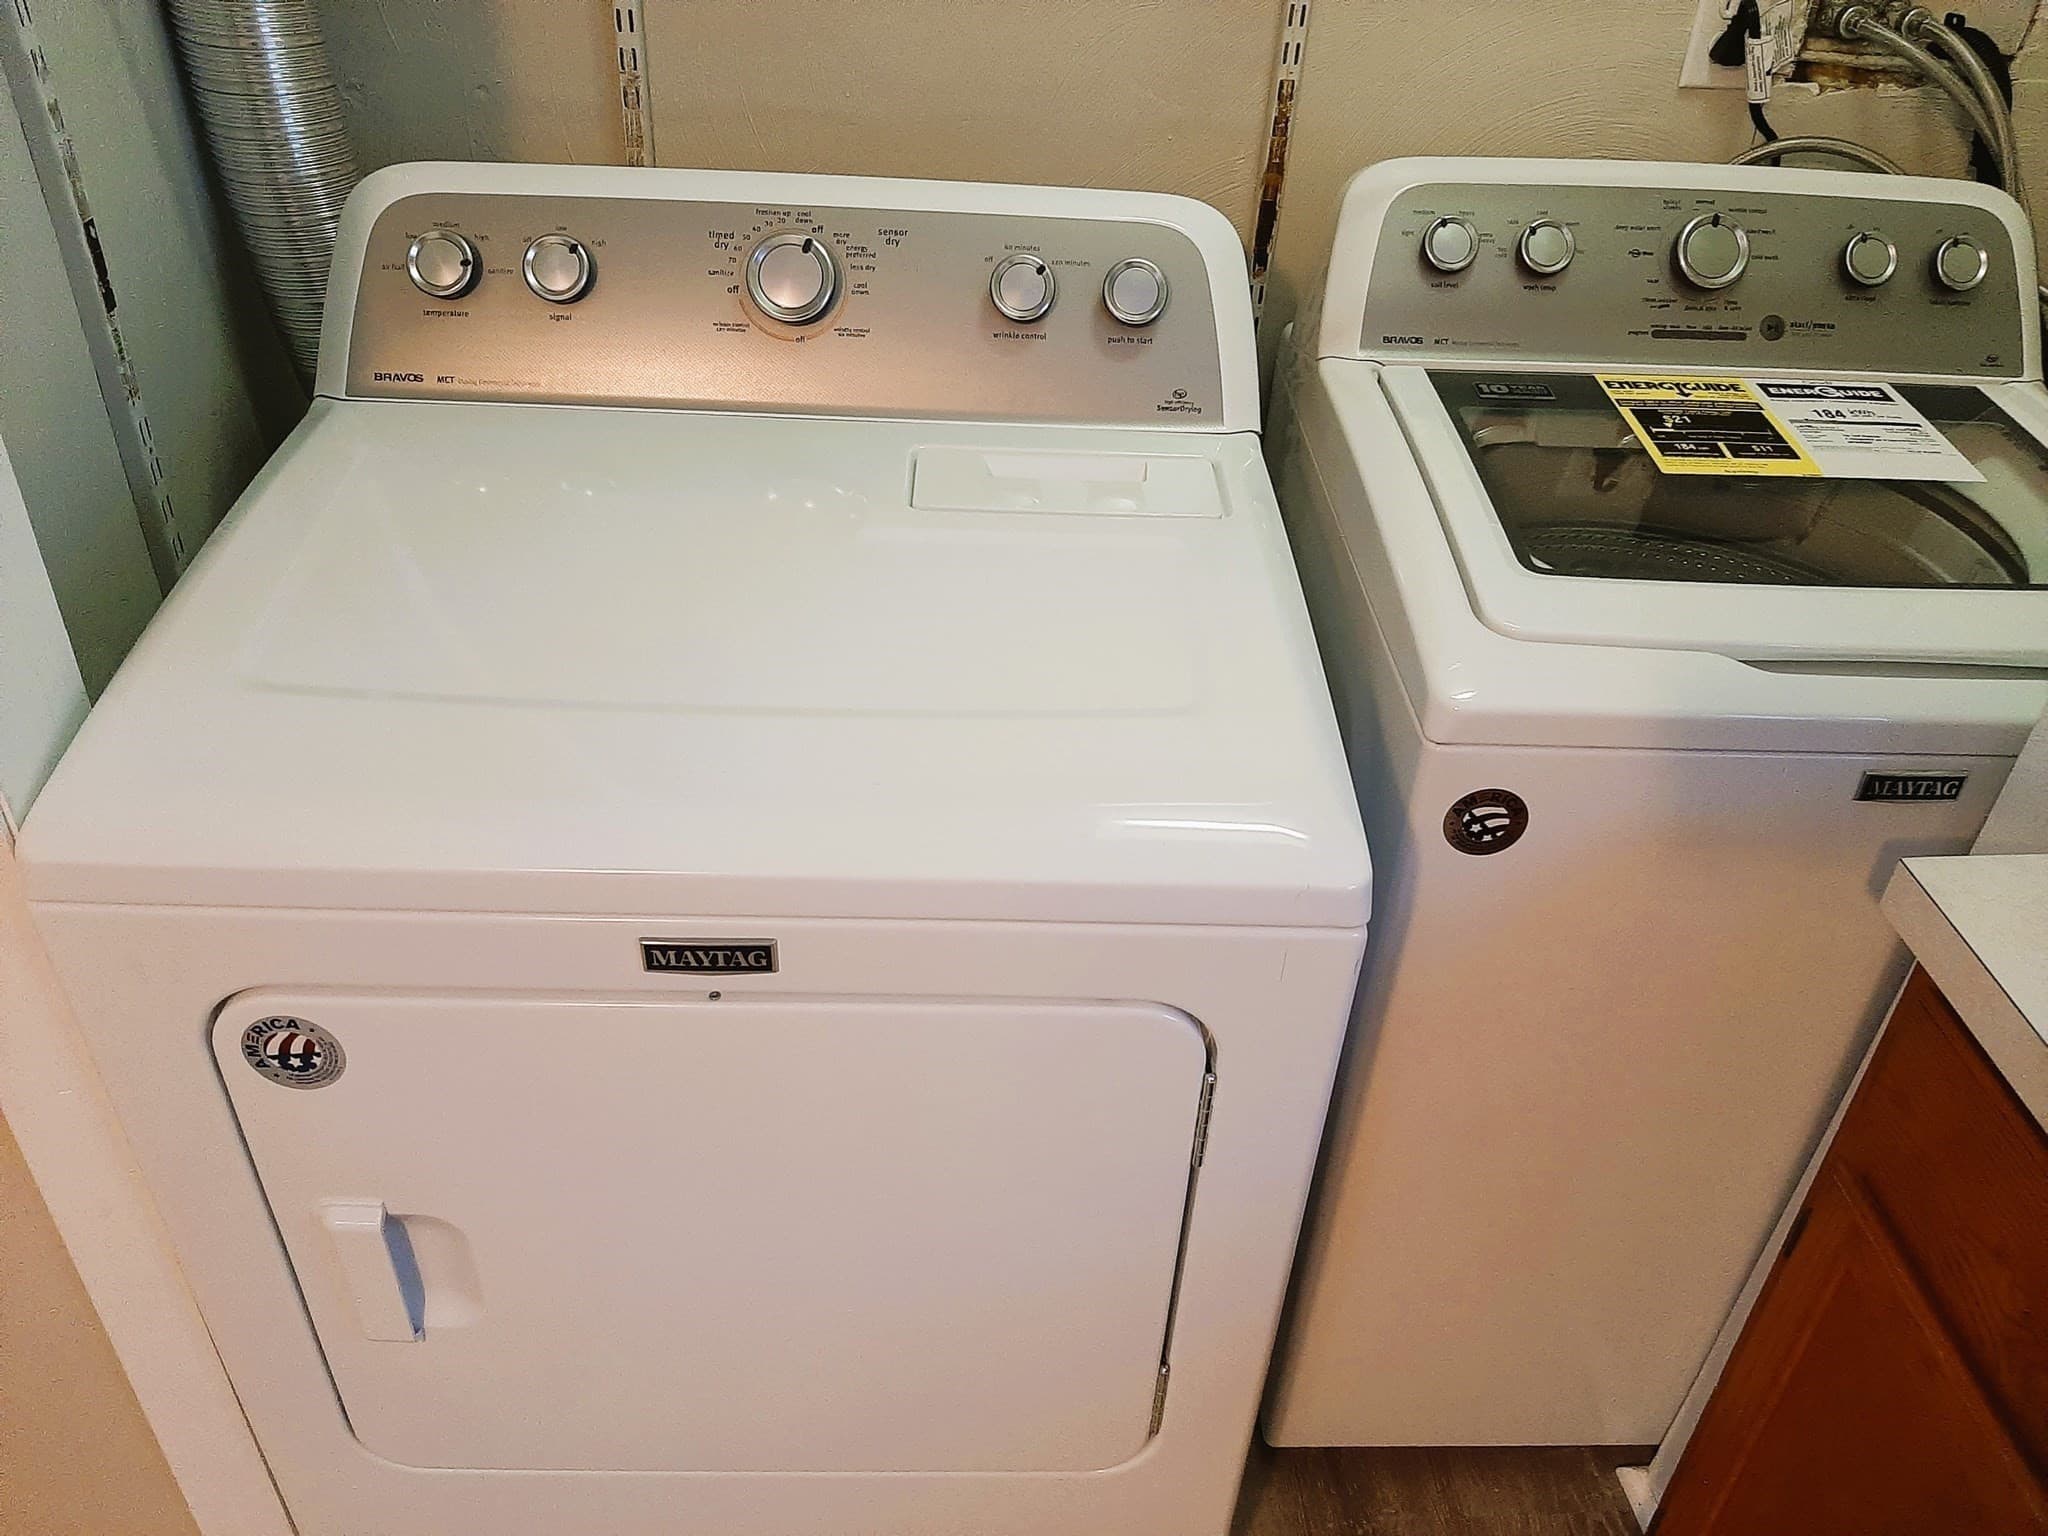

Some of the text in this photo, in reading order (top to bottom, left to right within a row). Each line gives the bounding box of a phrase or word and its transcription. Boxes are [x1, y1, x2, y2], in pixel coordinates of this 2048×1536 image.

[752, 225, 762, 233] 40
[811, 225, 824, 234] off
[878, 229, 909, 238] sensor
[708, 230, 735, 240] timed
[742, 233, 751, 241] 50
[714, 240, 729, 251] dry
[885, 237, 900, 247] dry
[1014, 244, 1041, 253] minutes
[1064, 259, 1091, 268] minutes
[727, 285, 740, 294] off
[422, 308, 470, 319] temperature
[549, 312, 573, 322] signal
[795, 335, 806, 344] off
[992, 331, 1047, 341] wrinkle control
[1108, 335, 1153, 345] push to start
[1382, 335, 1425, 345] BRAVOS
[373, 372, 425, 383] BRAVOS
[437, 376, 456, 385] MCT
[1477, 383, 1510, 394] 10
[1811, 408, 1847, 419] 184
[1673, 443, 1697, 451] 184
[1867, 780, 1960, 796] MAYTAG
[650, 949, 768, 968] MAYTAG
[244, 1018, 300, 1069] AMERICA
